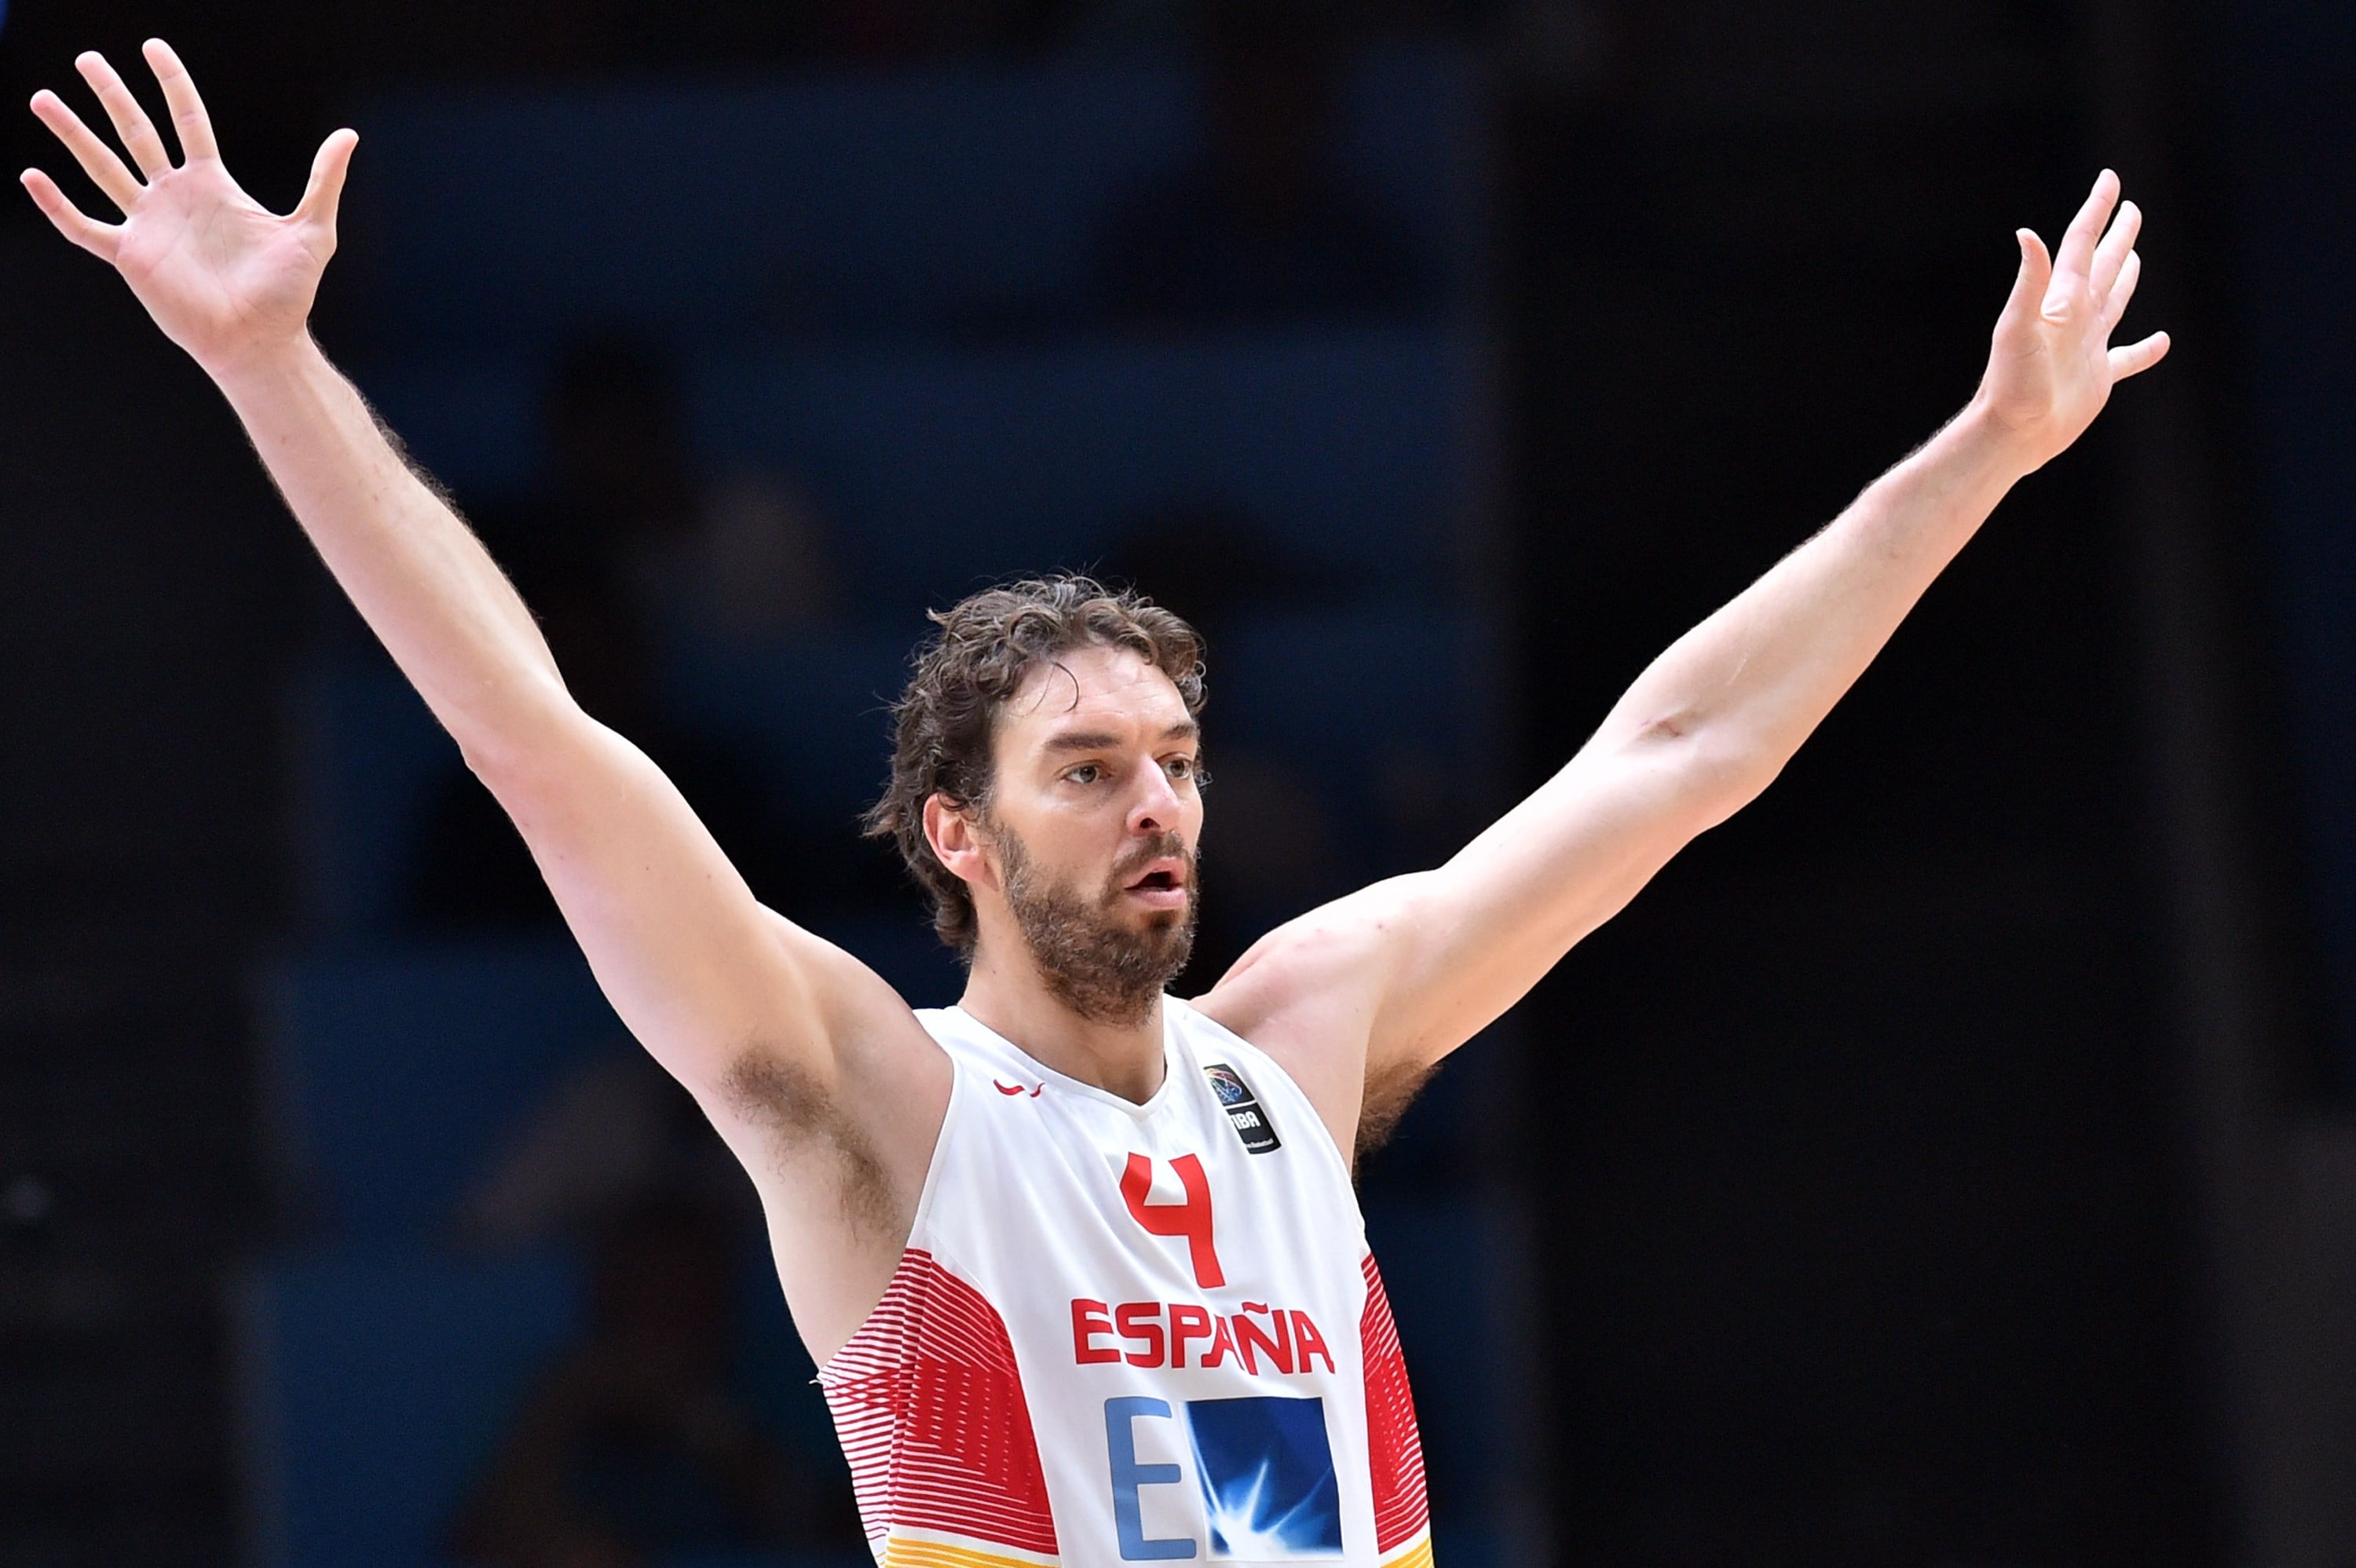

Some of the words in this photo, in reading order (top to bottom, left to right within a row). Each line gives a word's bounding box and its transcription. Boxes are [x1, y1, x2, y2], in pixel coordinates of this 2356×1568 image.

[1231, 1110, 1261, 1130] IBA
[1120, 1153, 1225, 1288] 4
[1071, 1299, 1335, 1375] ESPAÑA
[1104, 1396, 1196, 1561] E
